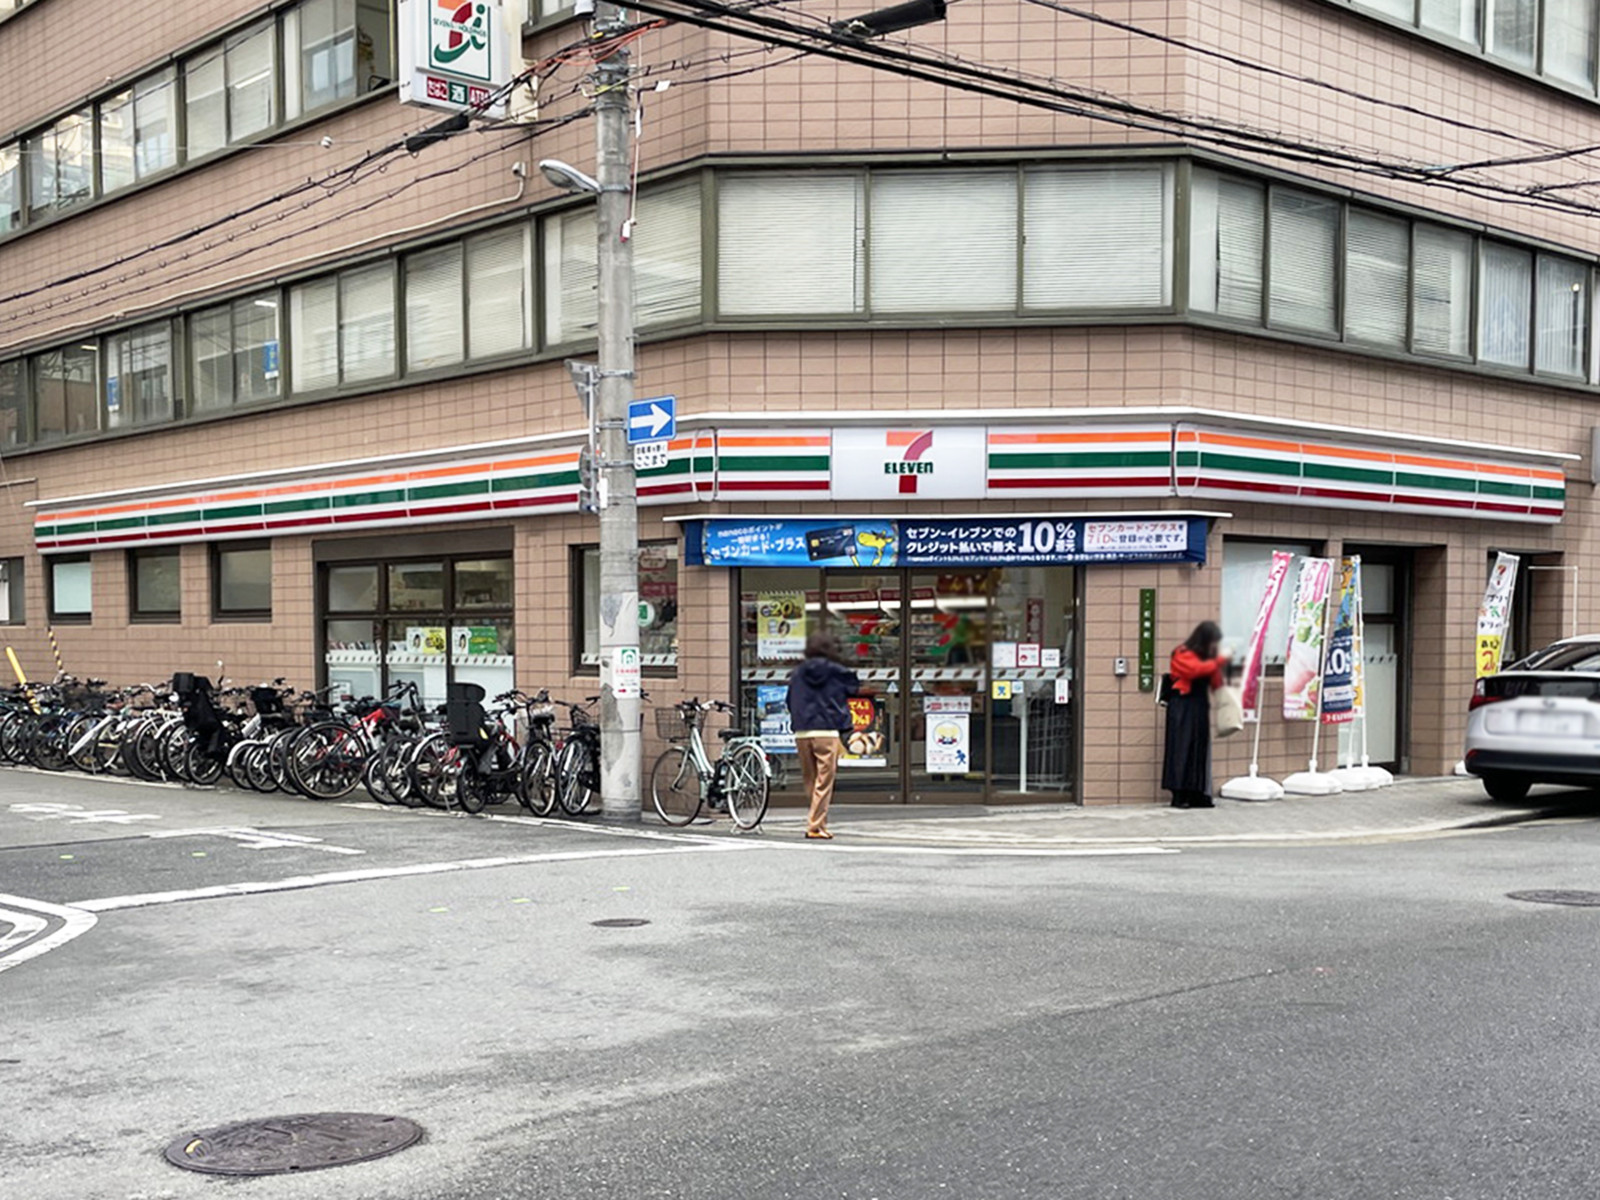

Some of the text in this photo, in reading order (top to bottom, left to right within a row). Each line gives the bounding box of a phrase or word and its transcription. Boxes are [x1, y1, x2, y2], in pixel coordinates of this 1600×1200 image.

[451, 84, 465, 103] 酒
[906, 527, 1017, 539] セブン-イレブンでの
[711, 537, 806, 560] セブンカード・プラス
[906, 541, 1017, 554] クレジット払いで最大
